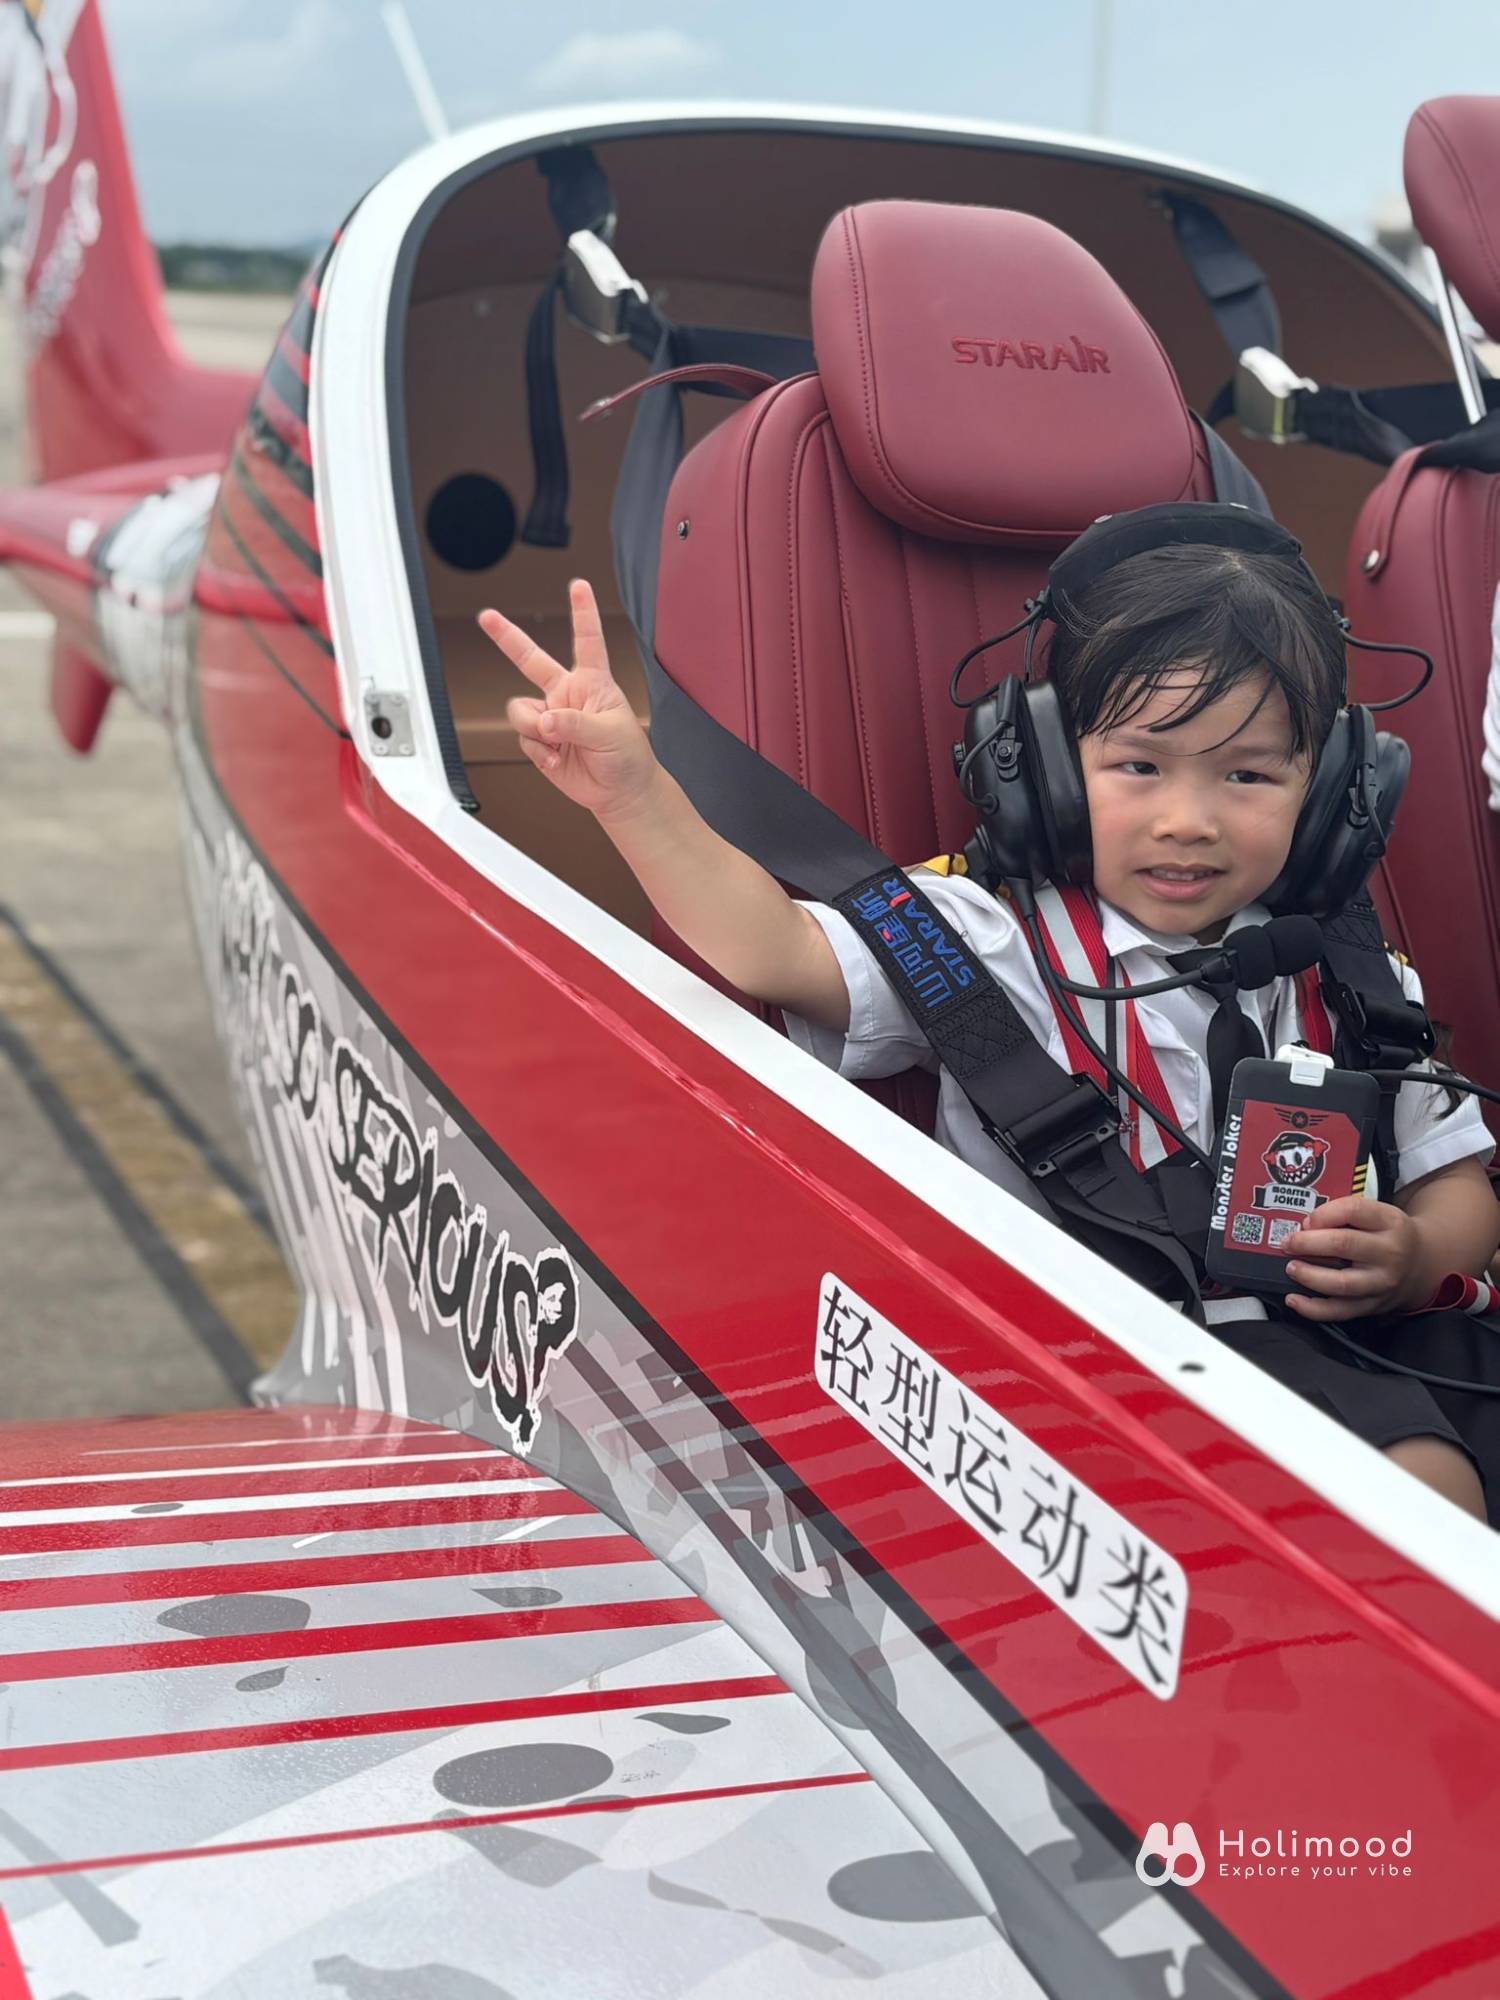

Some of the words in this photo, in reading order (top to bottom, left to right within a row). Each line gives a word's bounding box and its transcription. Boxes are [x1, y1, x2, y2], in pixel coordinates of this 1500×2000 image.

[952, 336, 1111, 374] STARAIR
[851, 886, 952, 1008] 山河星航
[882, 878, 976, 987] STARAIR
[1210, 1166, 1233, 1231] Monster
[1222, 1114, 1242, 1158] Joker
[1273, 1195, 1306, 1207] JOKER
[821, 1285, 1177, 1686] 轻型运动类
